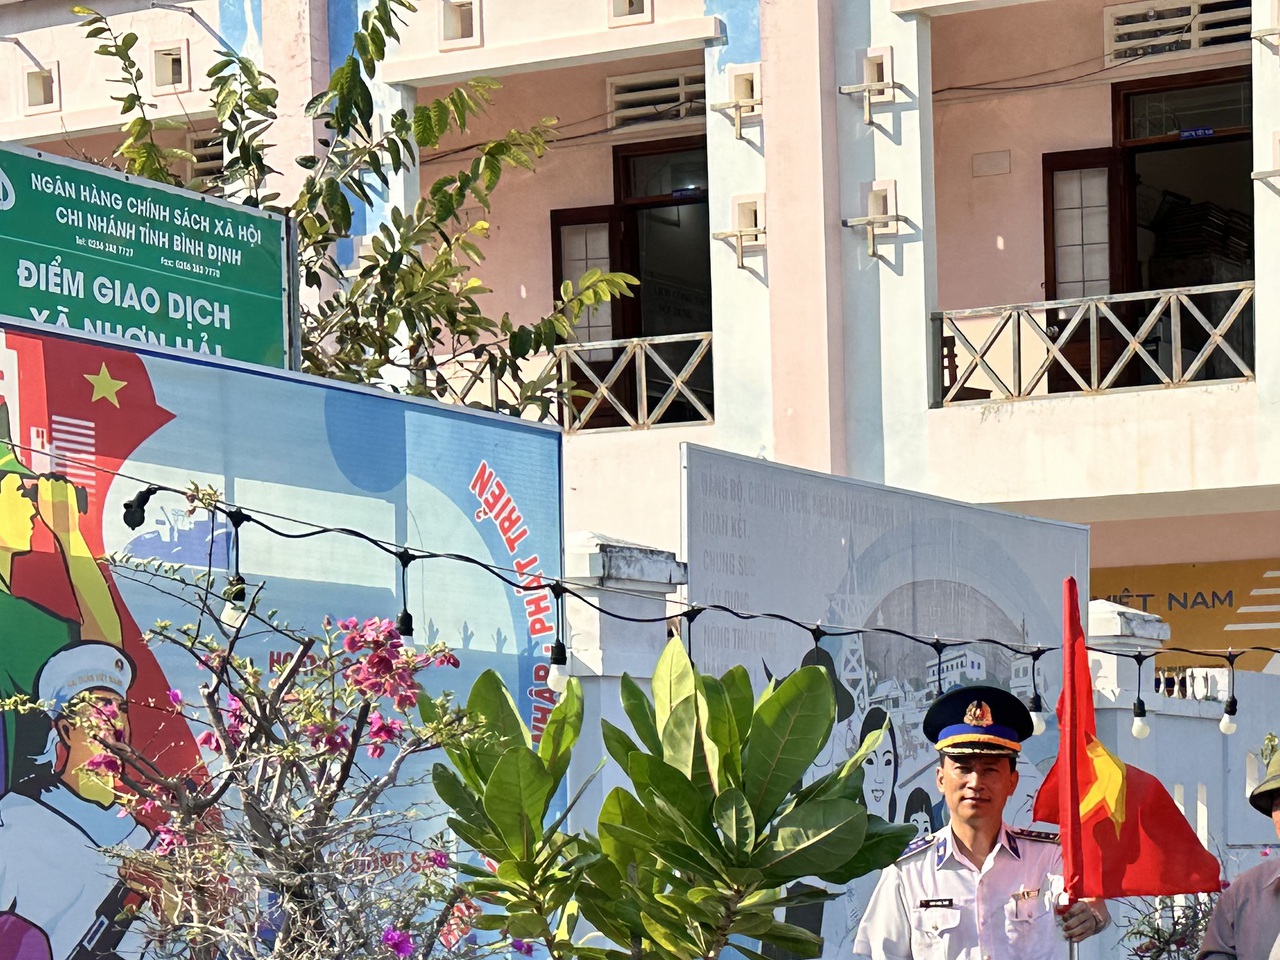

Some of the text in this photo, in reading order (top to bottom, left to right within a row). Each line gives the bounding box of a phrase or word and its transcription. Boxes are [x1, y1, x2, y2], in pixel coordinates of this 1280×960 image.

[31, 172, 261, 248] NGÂN HÀNG CHÍNH SÁCH XÃ HỘI
[55, 206, 242, 267] CHI NHÁNH TỈNH BÌNH ĐỊNH
[17, 255, 231, 330] ĐIỂM GIAO DỊCH
[469, 459, 530, 555] TRIỂN
[514, 554, 555, 637] PHÁT
[1168, 589, 1234, 612] NAM
